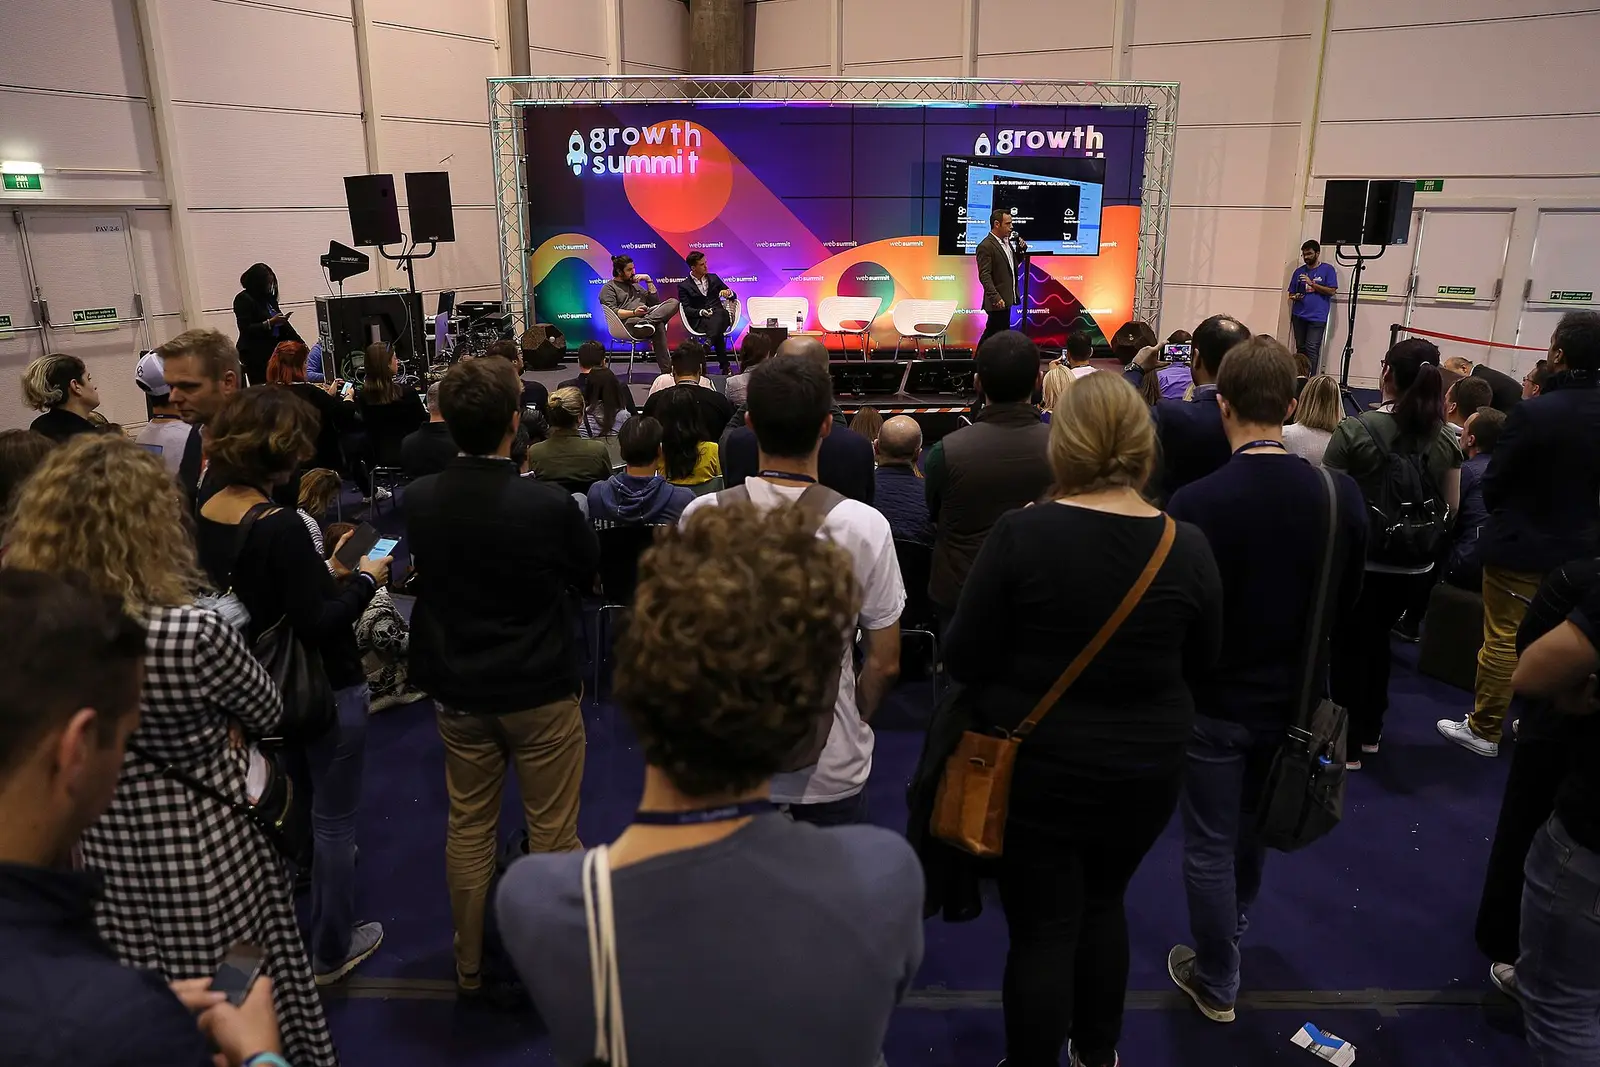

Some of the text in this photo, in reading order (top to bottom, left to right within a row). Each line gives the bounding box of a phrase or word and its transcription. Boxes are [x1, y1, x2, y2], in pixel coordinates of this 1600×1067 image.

[589, 122, 701, 153] growth
[996, 125, 1104, 154] growth
[592, 149, 699, 174] summit
